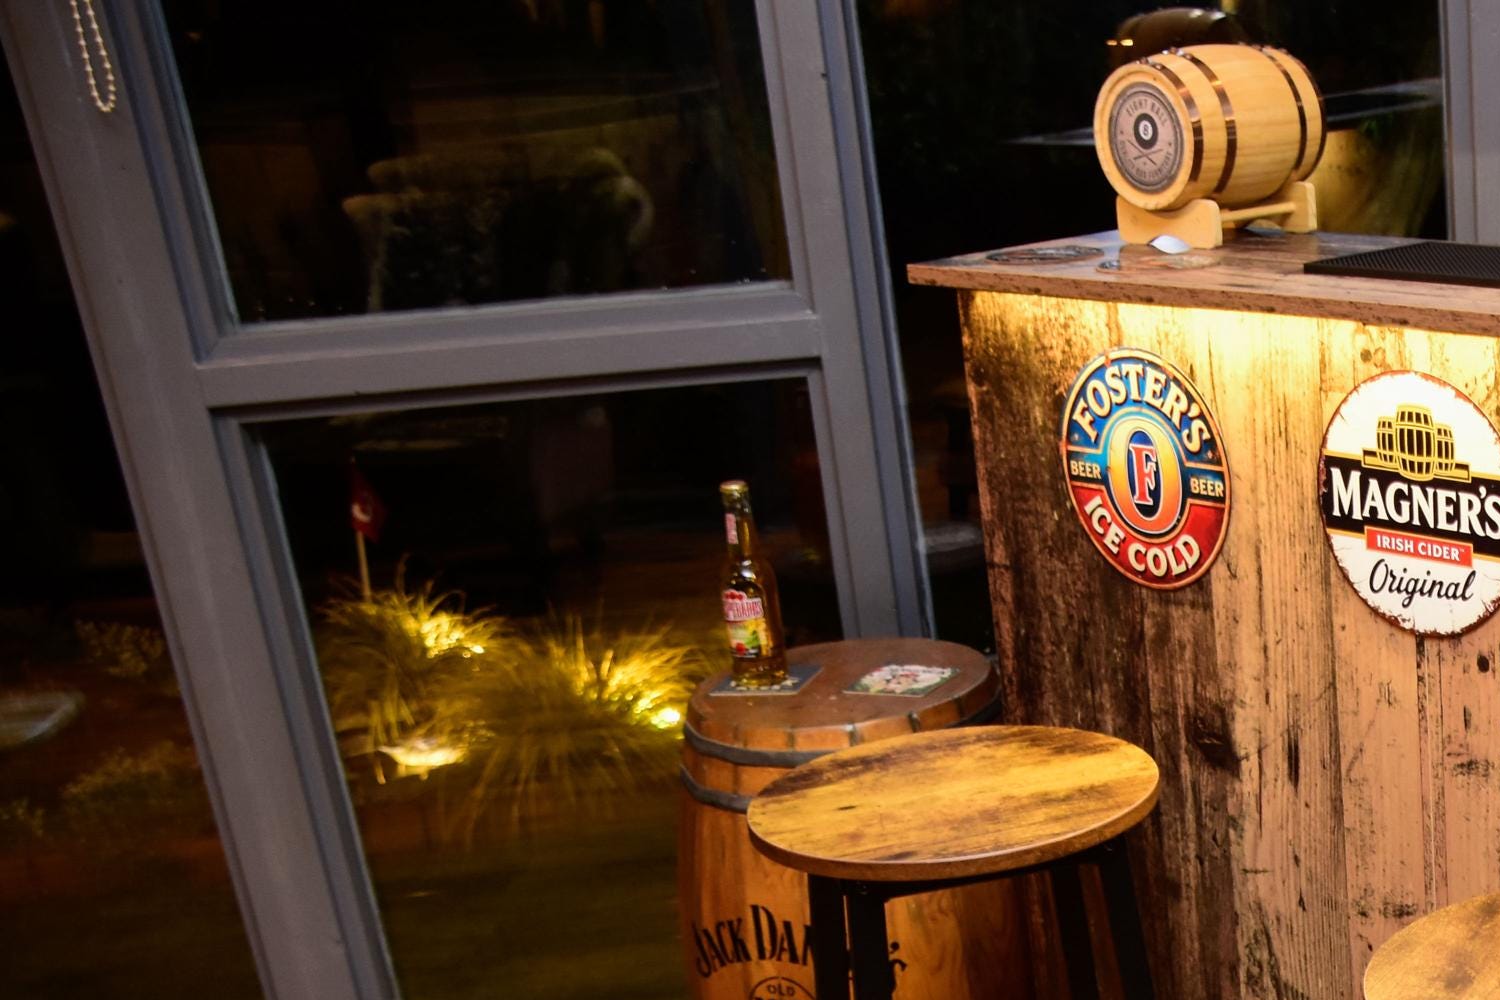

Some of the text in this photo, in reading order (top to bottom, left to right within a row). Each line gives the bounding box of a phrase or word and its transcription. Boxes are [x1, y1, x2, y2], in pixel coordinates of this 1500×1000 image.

[1072, 363, 1211, 454] FOSTER'S
[1070, 460, 1101, 479] BEER
[1190, 477, 1224, 498] BEER
[1084, 495, 1201, 578] ICE COLD
[1376, 533, 1461, 562] IRISH CIDER
[1369, 558, 1477, 608] Original
[695, 917, 752, 978] JACK
[767, 983, 796, 998] OLD
